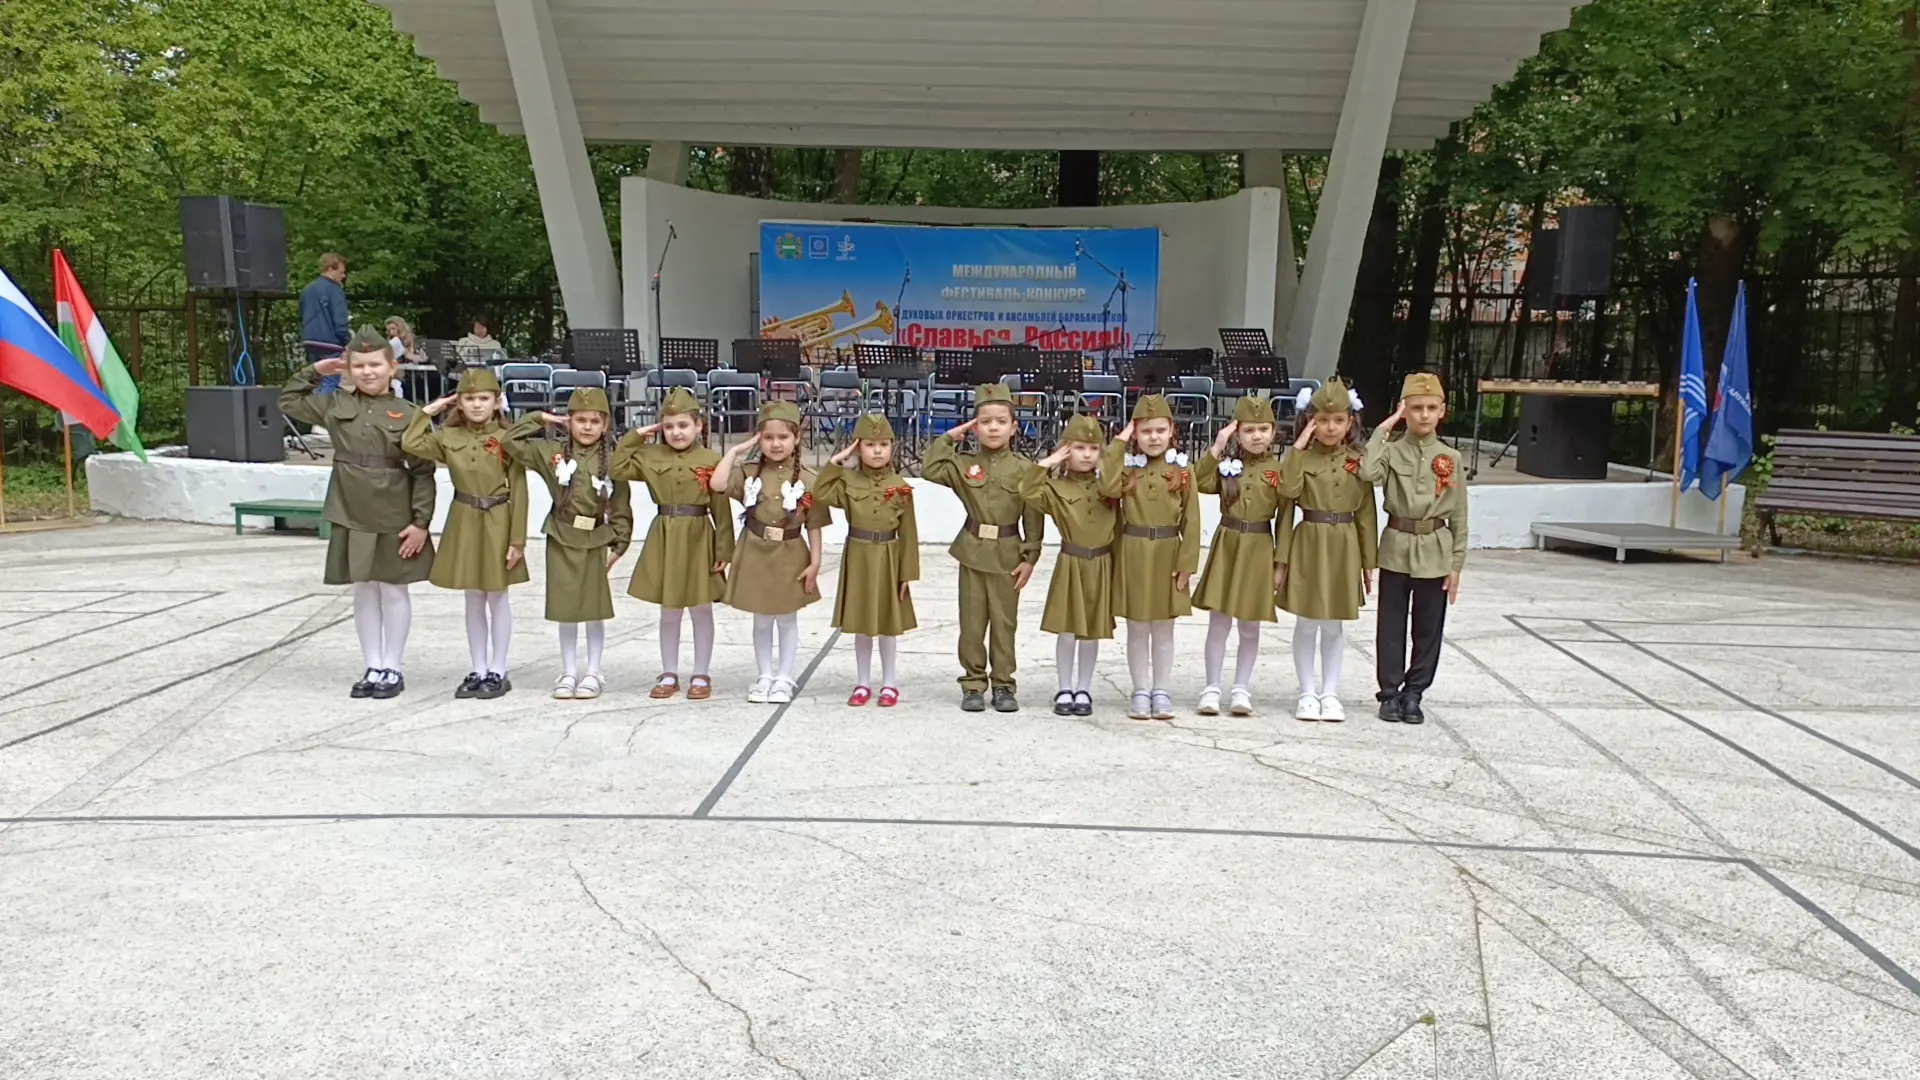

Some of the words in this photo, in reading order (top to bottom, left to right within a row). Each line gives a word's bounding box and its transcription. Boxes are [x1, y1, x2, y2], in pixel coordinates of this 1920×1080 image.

[952, 263, 1077, 281] МЕЖДУНАРОДНЫЙ
[902, 309, 943, 321] ДУХОВЫХ
[946, 310, 995, 321] ОРКЕСТРОВ
[998, 312, 1004, 321] И
[1006, 311, 1056, 322] АНСАМБЛЕЙ
